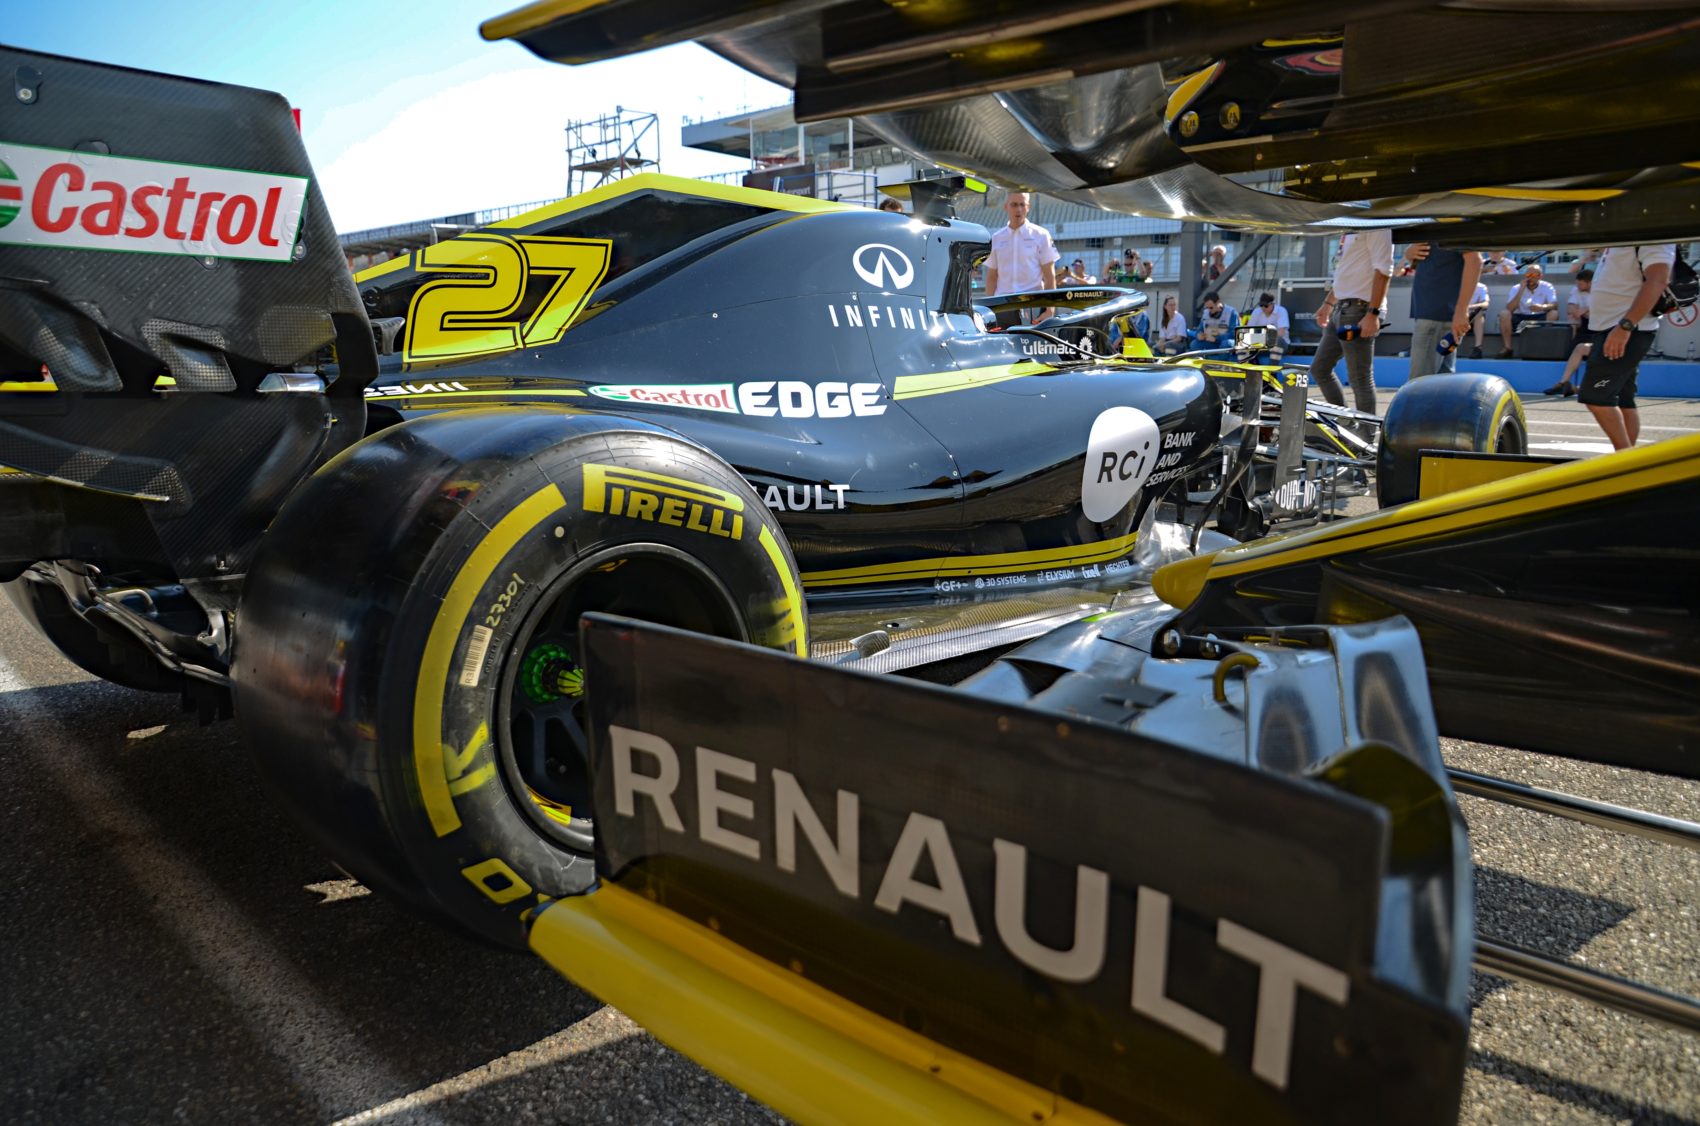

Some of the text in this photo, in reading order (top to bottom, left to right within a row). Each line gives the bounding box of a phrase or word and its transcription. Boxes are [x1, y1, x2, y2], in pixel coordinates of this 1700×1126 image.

[31, 162, 283, 247] Castrol
[402, 232, 614, 363] 27
[828, 304, 956, 332] INFINITI
[1023, 340, 1077, 355] ultimate
[630, 381, 888, 418] Castrol EDGE
[1164, 432, 1196, 449] BANK
[1156, 453, 1182, 470] AND
[582, 463, 745, 541] PIRELLI
[753, 484, 850, 511] AULT
[986, 575, 1027, 587] 3D SYSTEMS
[1045, 569, 1076, 581] ELYSIUM
[609, 725, 1350, 1090] RENAULT
